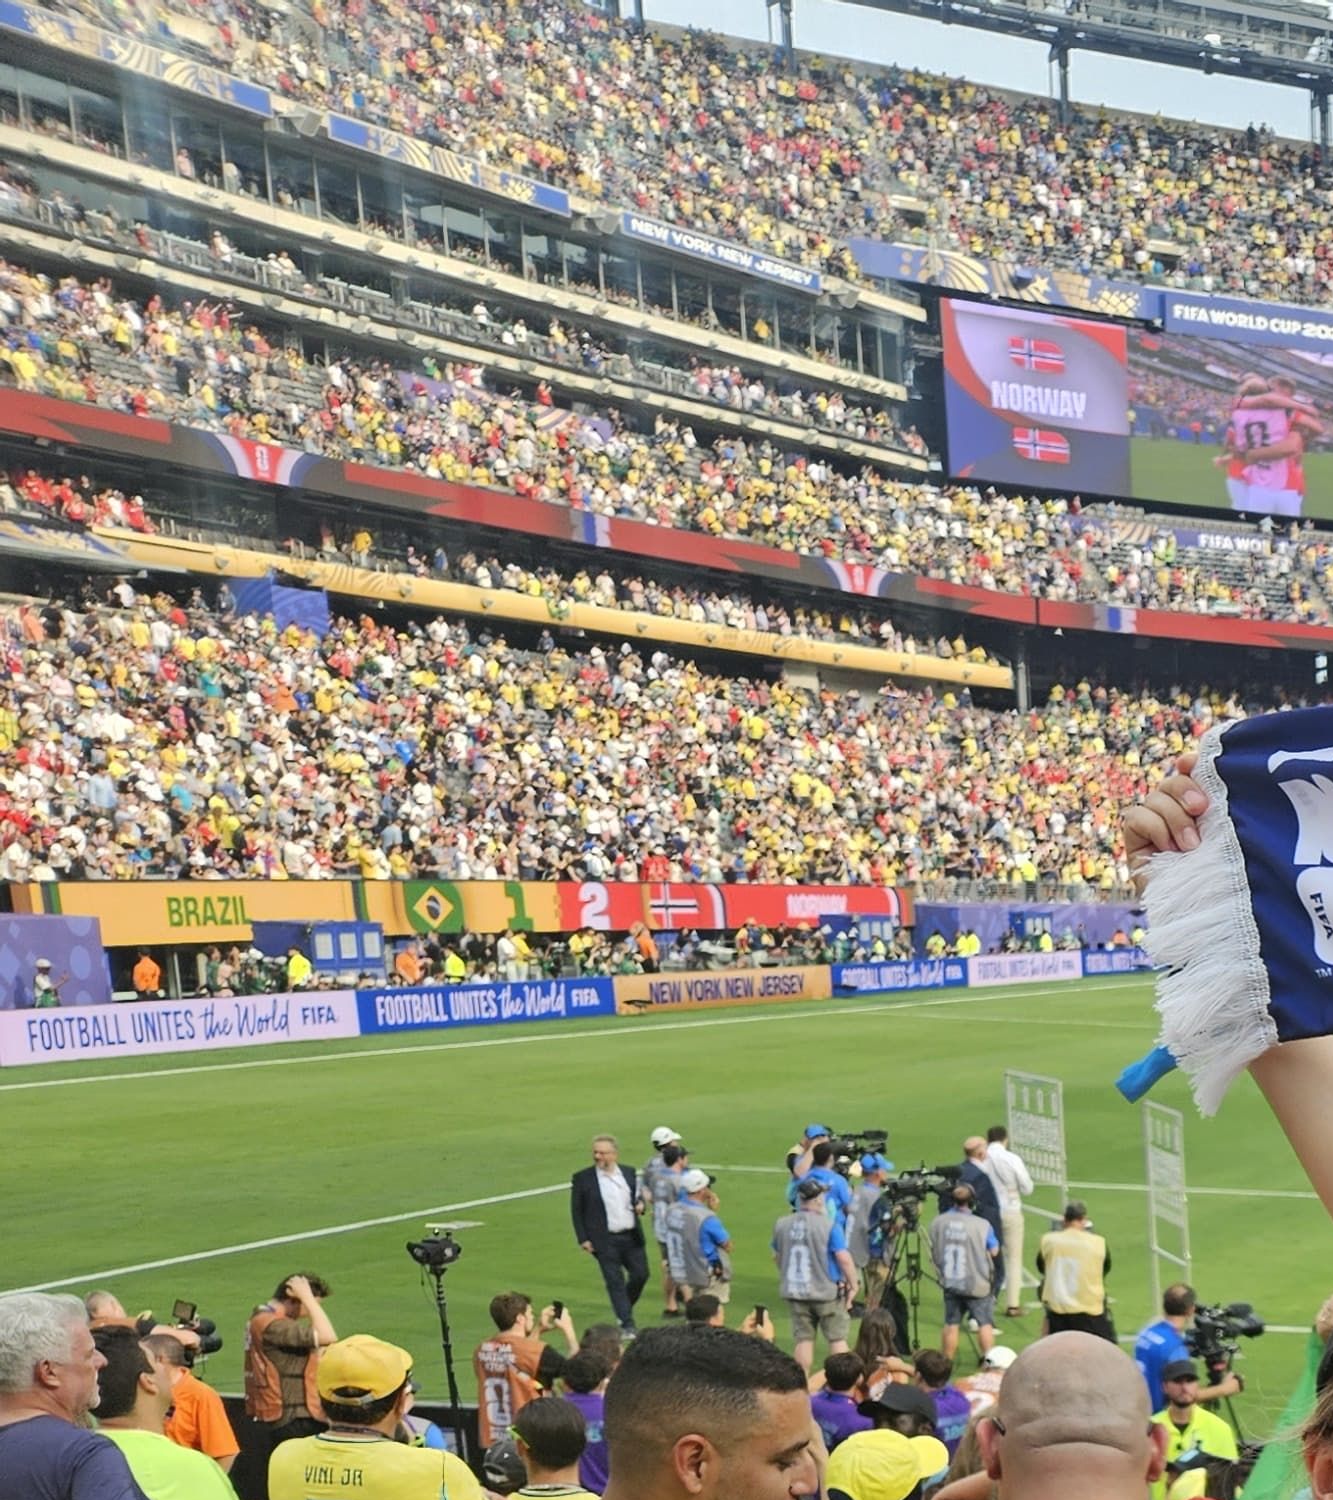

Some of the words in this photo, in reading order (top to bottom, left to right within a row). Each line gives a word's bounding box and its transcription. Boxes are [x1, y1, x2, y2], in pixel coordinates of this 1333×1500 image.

[631, 218, 669, 241] NEW
[672, 232, 716, 255] YORK
[717, 245, 752, 266] NEW
[755, 259, 812, 285] JERSEY
[1173, 304, 1209, 323] FIFA
[1210, 310, 1268, 330] WORLD
[1270, 318, 1300, 334] CUP
[991, 380, 1086, 419] NORWAY
[1198, 534, 1234, 550] FIFA
[166, 895, 252, 927] BRAZIL
[505, 880, 535, 931] 1
[579, 881, 612, 931] 2
[375, 992, 449, 1026] FOOTBALL
[449, 988, 498, 1021] UNITES
[498, 984, 525, 1018] the
[524, 981, 567, 1016] World
[571, 987, 600, 1008] FIFA
[650, 981, 682, 1004] NEW
[685, 978, 723, 1001] YORK
[726, 976, 754, 998] NEW
[758, 974, 806, 997] JERSEY
[27, 1013, 126, 1052] FOOTBALL
[132, 1008, 196, 1043] UNITES
[199, 1003, 233, 1040] the
[235, 998, 291, 1038] World
[302, 1005, 337, 1026] FIFA
[304, 1464, 333, 1484] VINI
